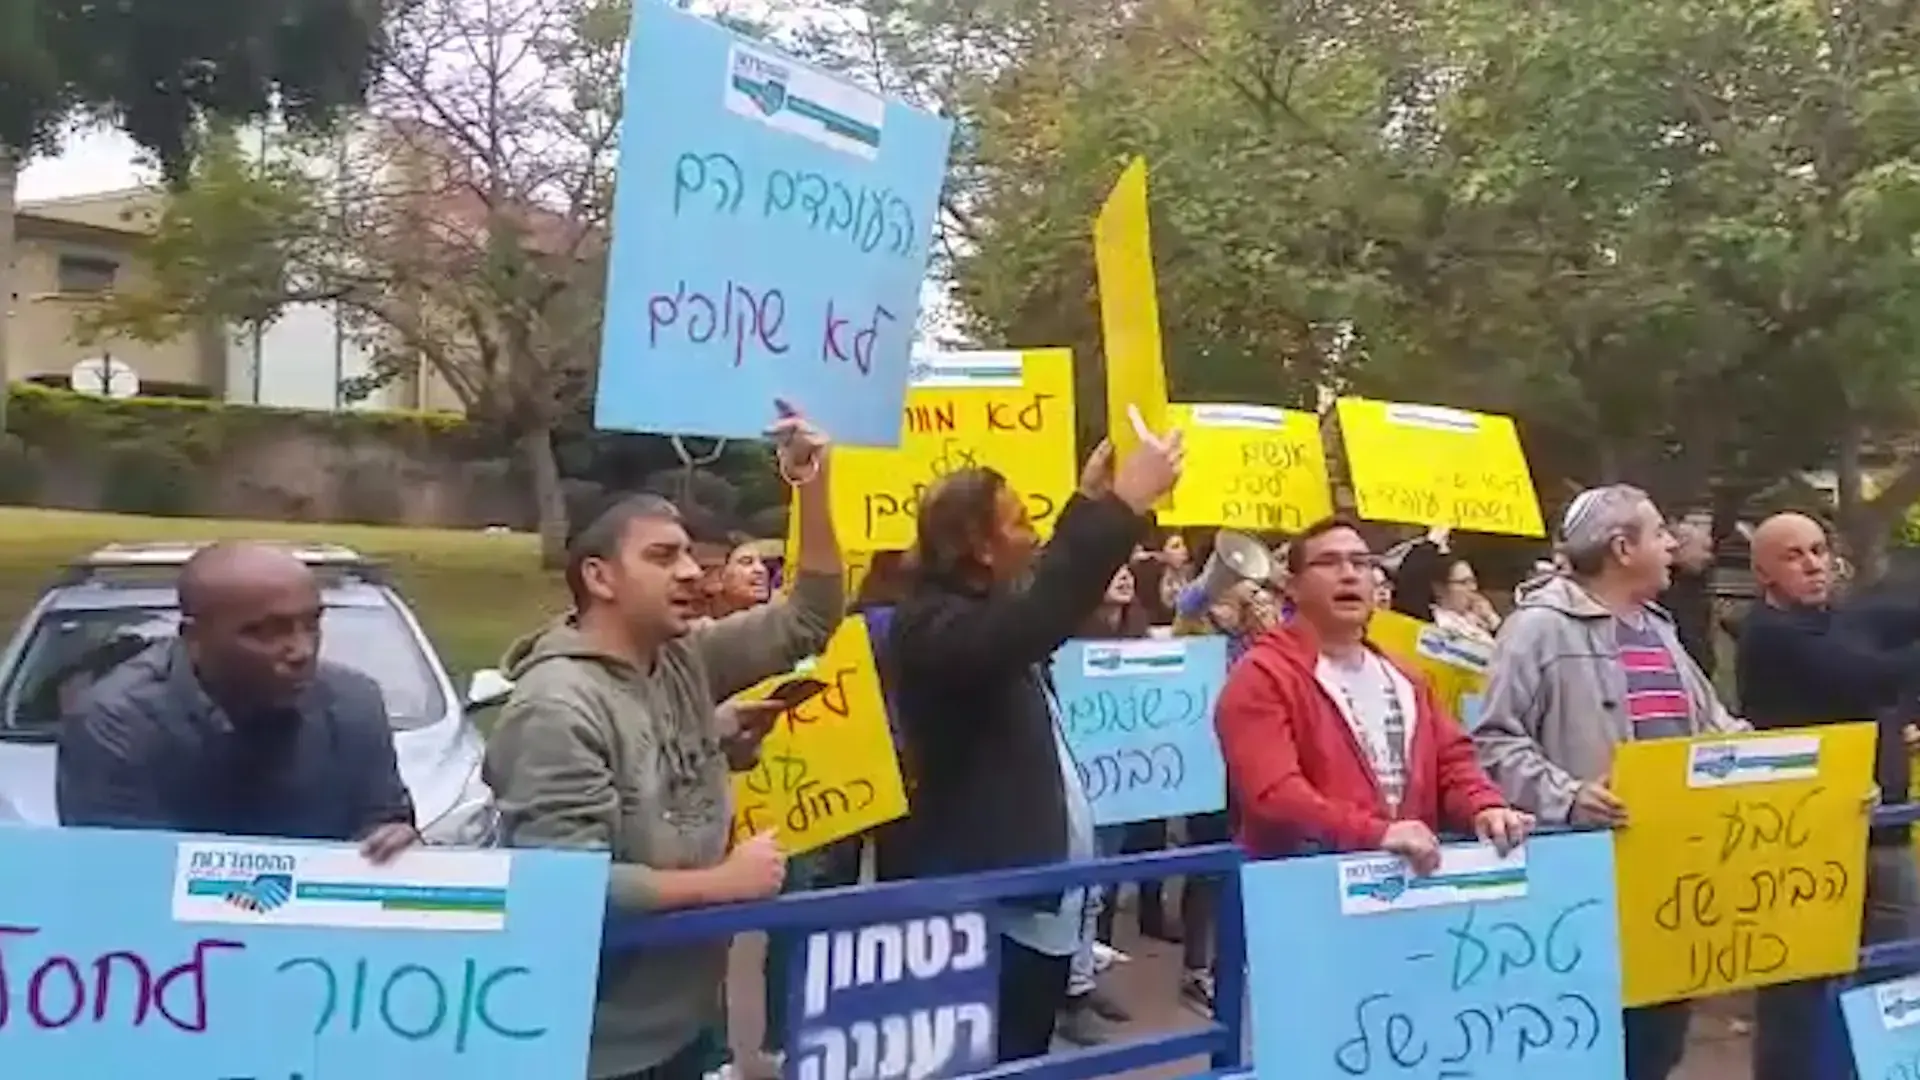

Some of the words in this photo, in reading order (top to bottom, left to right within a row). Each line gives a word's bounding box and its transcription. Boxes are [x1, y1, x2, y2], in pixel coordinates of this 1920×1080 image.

[674, 153, 744, 218] הם
[648, 280, 789, 367] שקופים
[822, 302, 897, 376] לא
[985, 394, 1055, 431] לא
[786, 667, 857, 734] לא
[786, 777, 875, 832] כחול
[191, 851, 296, 871] ההסתדרות
[1736, 860, 1849, 913] הבית
[1655, 873, 1722, 930] של
[804, 911, 987, 1018] בטחון
[277, 957, 547, 1053] אסור
[1335, 994, 1429, 1076] של
[1441, 993, 1601, 1064] הבית
[799, 1002, 992, 1080] רעננה
